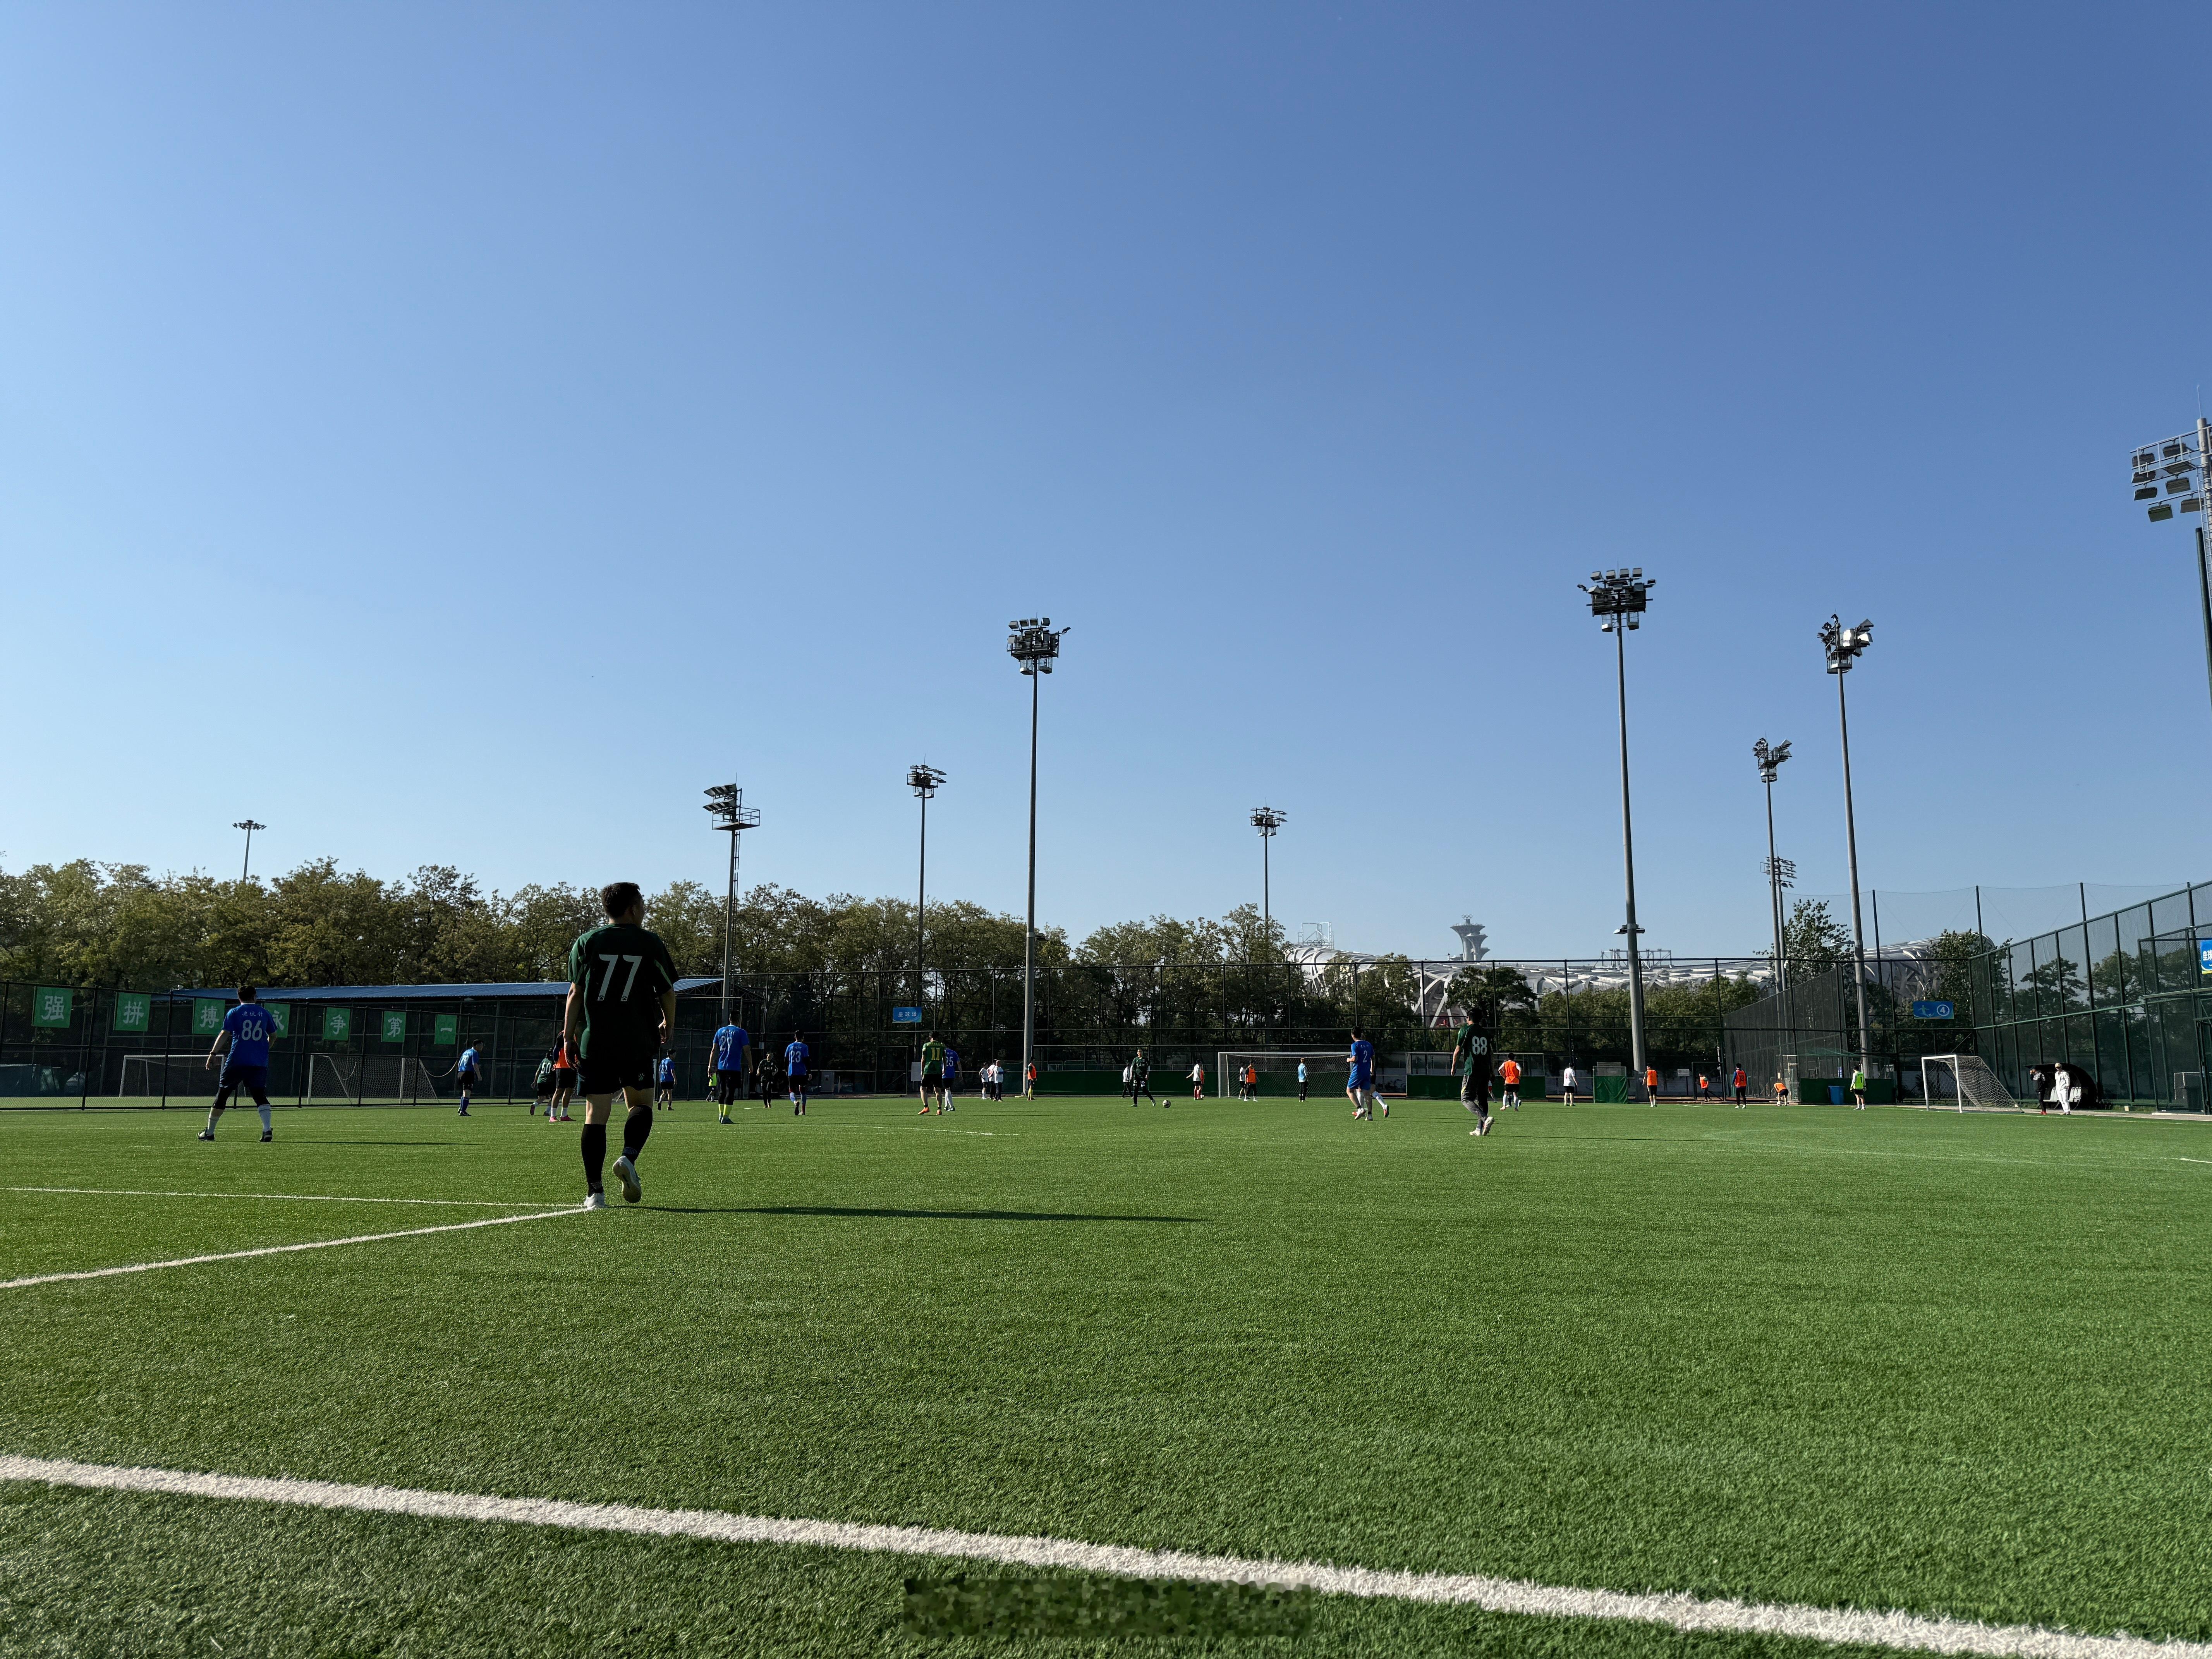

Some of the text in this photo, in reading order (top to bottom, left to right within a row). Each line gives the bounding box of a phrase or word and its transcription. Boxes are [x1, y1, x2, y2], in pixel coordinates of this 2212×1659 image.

[598, 954, 643, 1001] 77
[41, 995, 64, 1020] 强
[123, 1001, 144, 1025] 拼
[200, 1006, 220, 1029] 搏
[241, 1019, 263, 1041] 86
[330, 1015, 346, 1035] 争
[388, 1017, 403, 1037] 第
[720, 1036, 733, 1053] 29
[931, 1047, 940, 1060] 11
[1472, 1036, 1487, 1056] 88
[790, 1051, 801, 1063] 23
[946, 1056, 953, 1066] 25
[1363, 1050, 1367, 1063] 2
